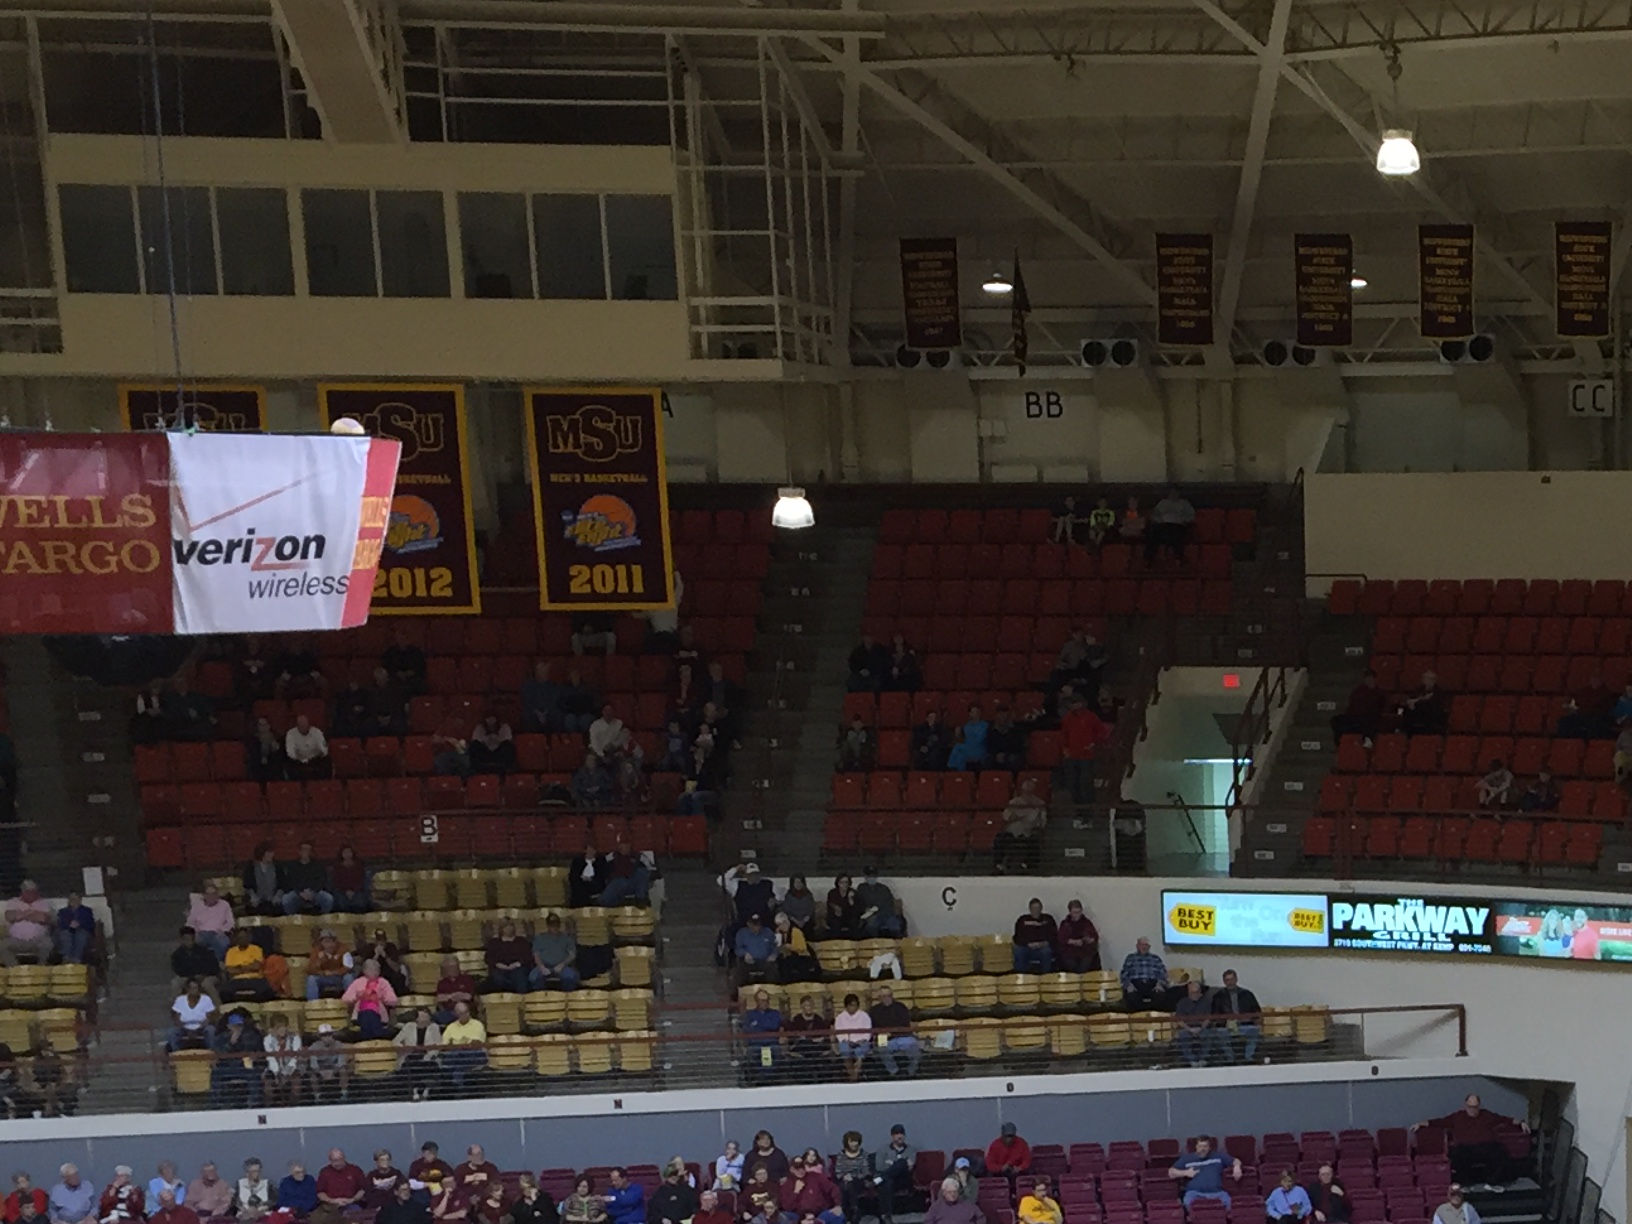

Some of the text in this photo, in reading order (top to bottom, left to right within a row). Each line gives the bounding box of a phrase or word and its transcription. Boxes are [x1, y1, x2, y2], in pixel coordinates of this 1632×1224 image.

[1025, 391, 1064, 418] BB
[1571, 383, 1606, 413] CC
[546, 404, 642, 462] MSU
[0, 493, 157, 529] ELLS
[0, 539, 161, 575] ARGO
[173, 527, 327, 571] verizon
[248, 570, 350, 599] wireless
[373, 566, 453, 598] 2012
[568, 563, 645, 594] 2011
[421, 815, 437, 837] B
[942, 886, 957, 907] C
[1397, 897, 1424, 908] THE
[1177, 907, 1215, 921] BEST
[1178, 918, 1213, 931] BUY
[1332, 901, 1490, 936] PARKWAY
[1372, 930, 1452, 943] GRILL
